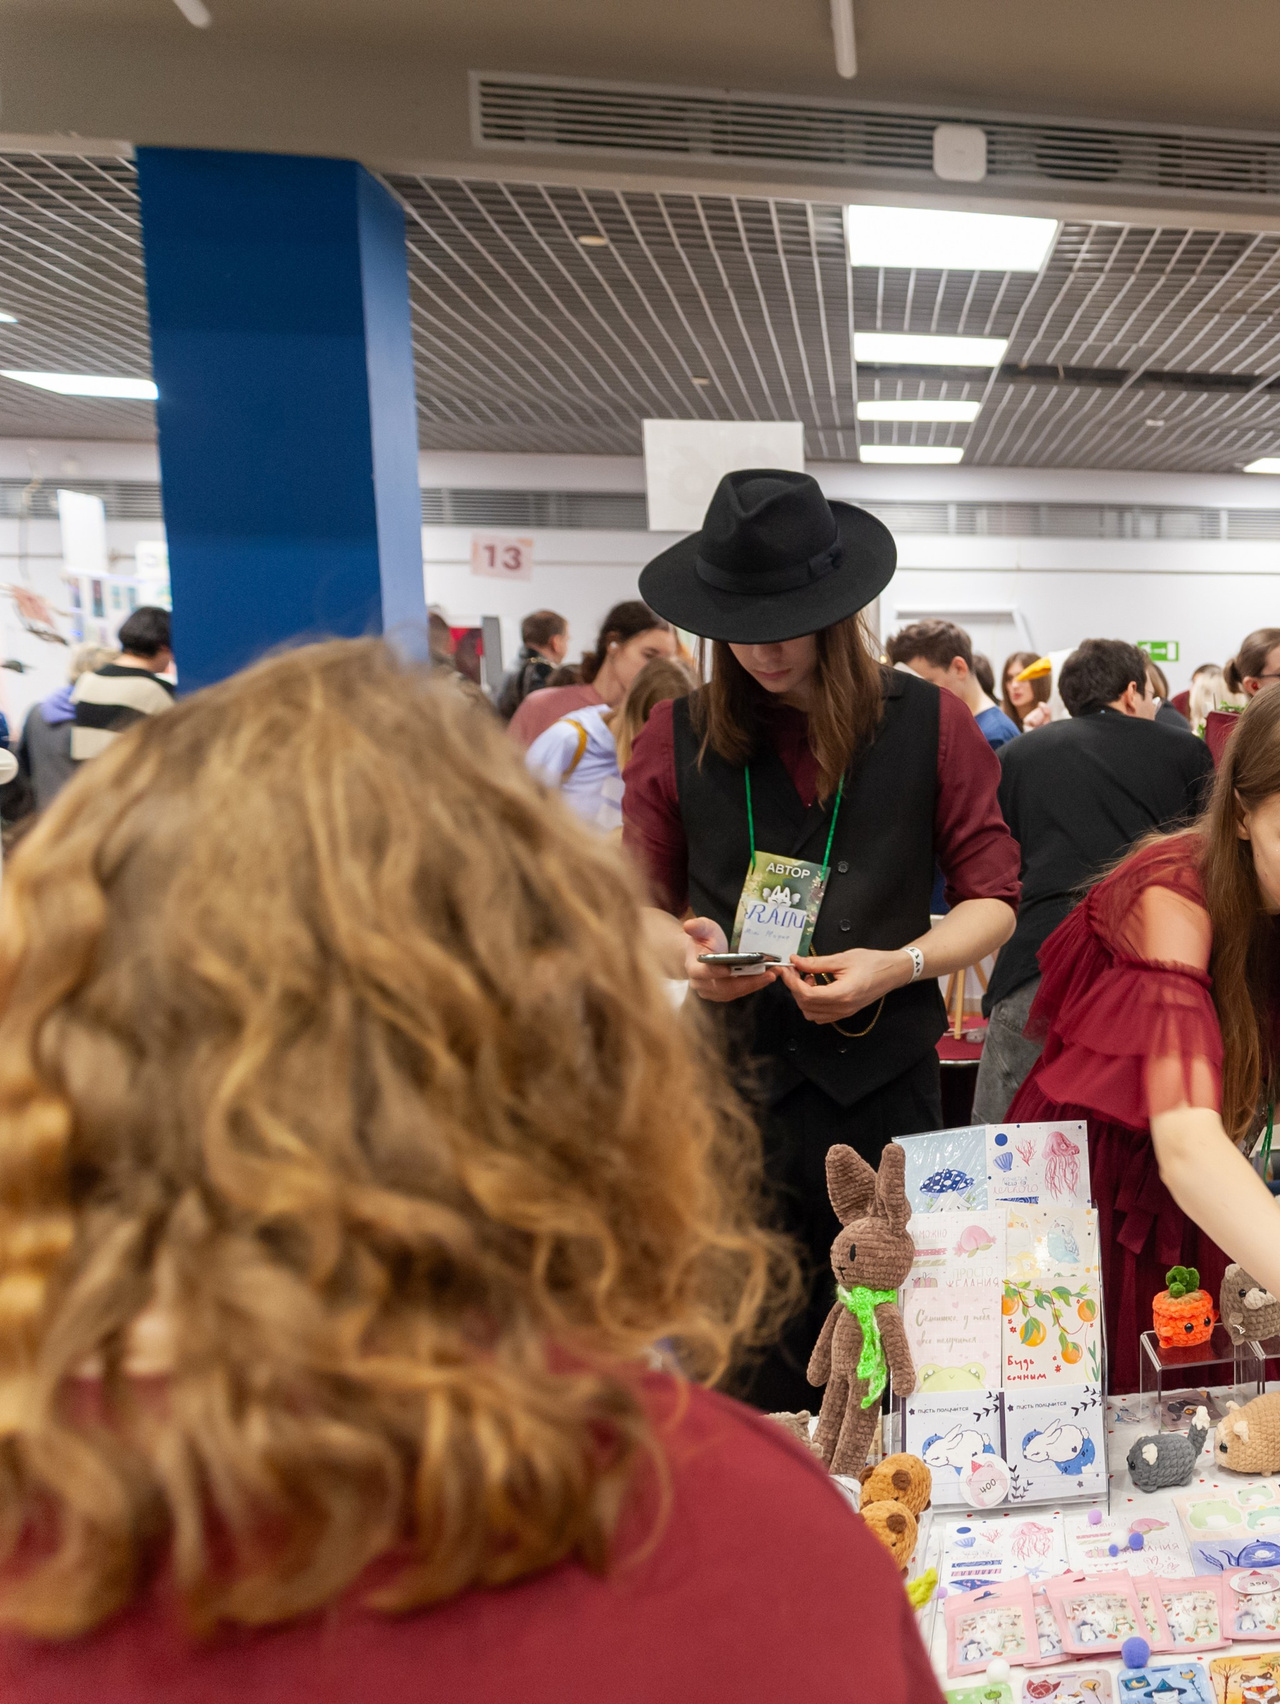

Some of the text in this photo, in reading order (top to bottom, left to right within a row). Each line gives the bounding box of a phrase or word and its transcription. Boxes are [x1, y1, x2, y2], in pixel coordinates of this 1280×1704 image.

[483, 544, 521, 570] 13
[766, 862, 810, 879] АВТОР
[745, 903, 806, 929] RAIN
[1007, 1355, 1035, 1371] Будь
[1007, 1373, 1047, 1381] сочным
[980, 1478, 996, 1493] 400
